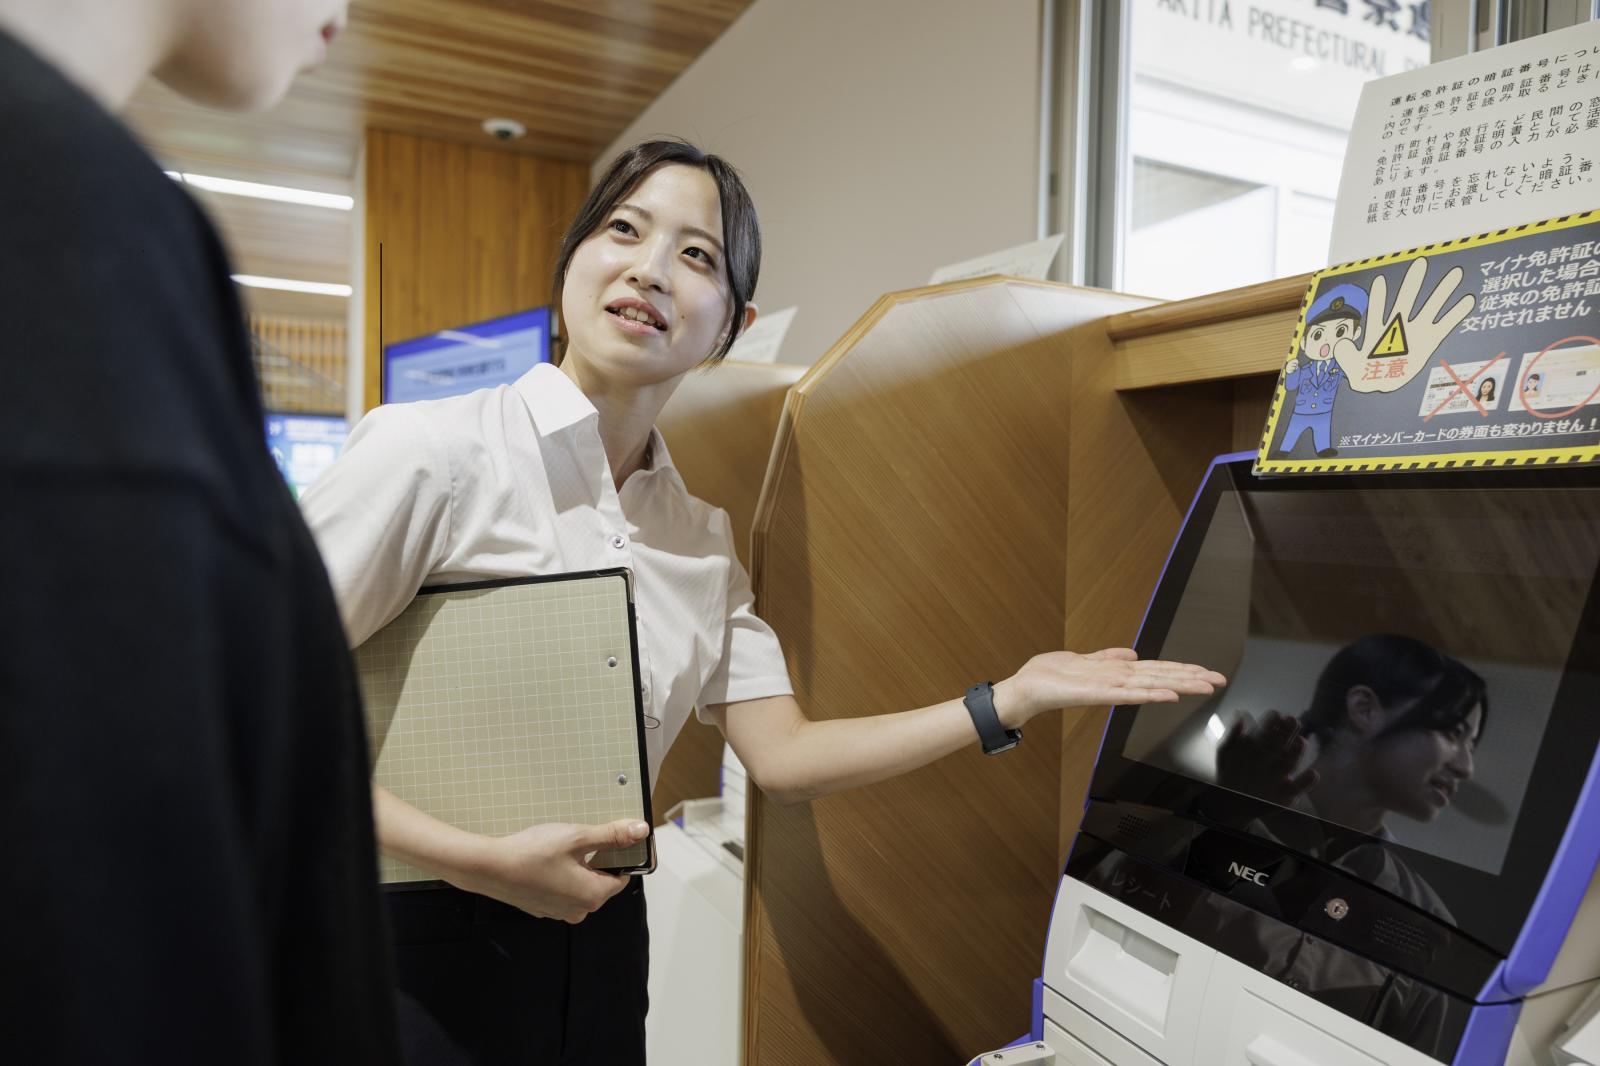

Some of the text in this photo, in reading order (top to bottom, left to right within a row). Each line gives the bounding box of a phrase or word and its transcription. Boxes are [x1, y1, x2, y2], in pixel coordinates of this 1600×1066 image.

[1247, 6, 1386, 76] PREFECTURAL
[1384, 70, 1600, 131] 内のデータを読み取るとき
[1480, 259, 1600, 294] 選択した場合
[1479, 278, 1600, 313] 従来の免許証
[1361, 358, 1408, 381] 注意
[1111, 868, 1172, 911] レシート
[1228, 861, 1270, 888] NEC
